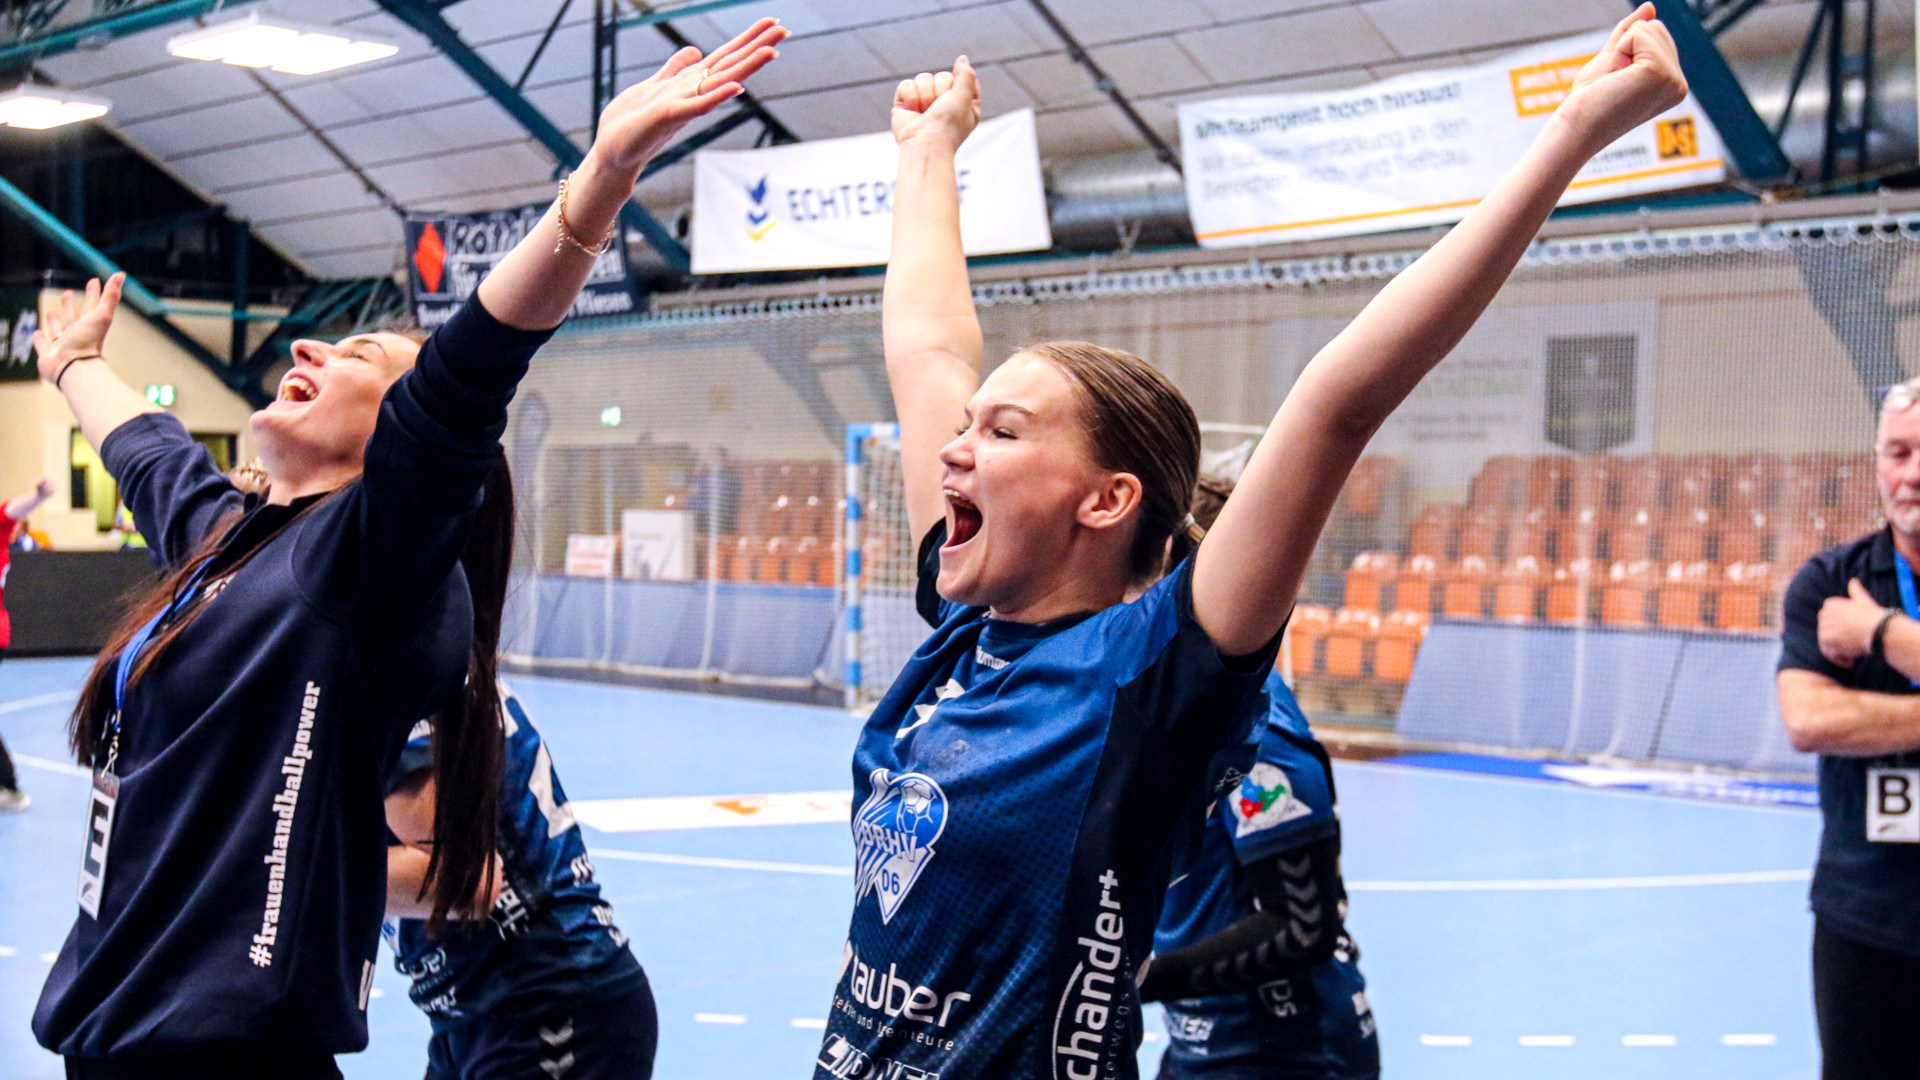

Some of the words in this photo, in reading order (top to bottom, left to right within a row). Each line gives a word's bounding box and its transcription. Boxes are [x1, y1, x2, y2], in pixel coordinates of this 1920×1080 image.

[249, 681, 321, 968] #frauenhandballpower
[1878, 775, 1912, 815] B
[83, 797, 110, 879] E
[881, 868, 901, 896] 06
